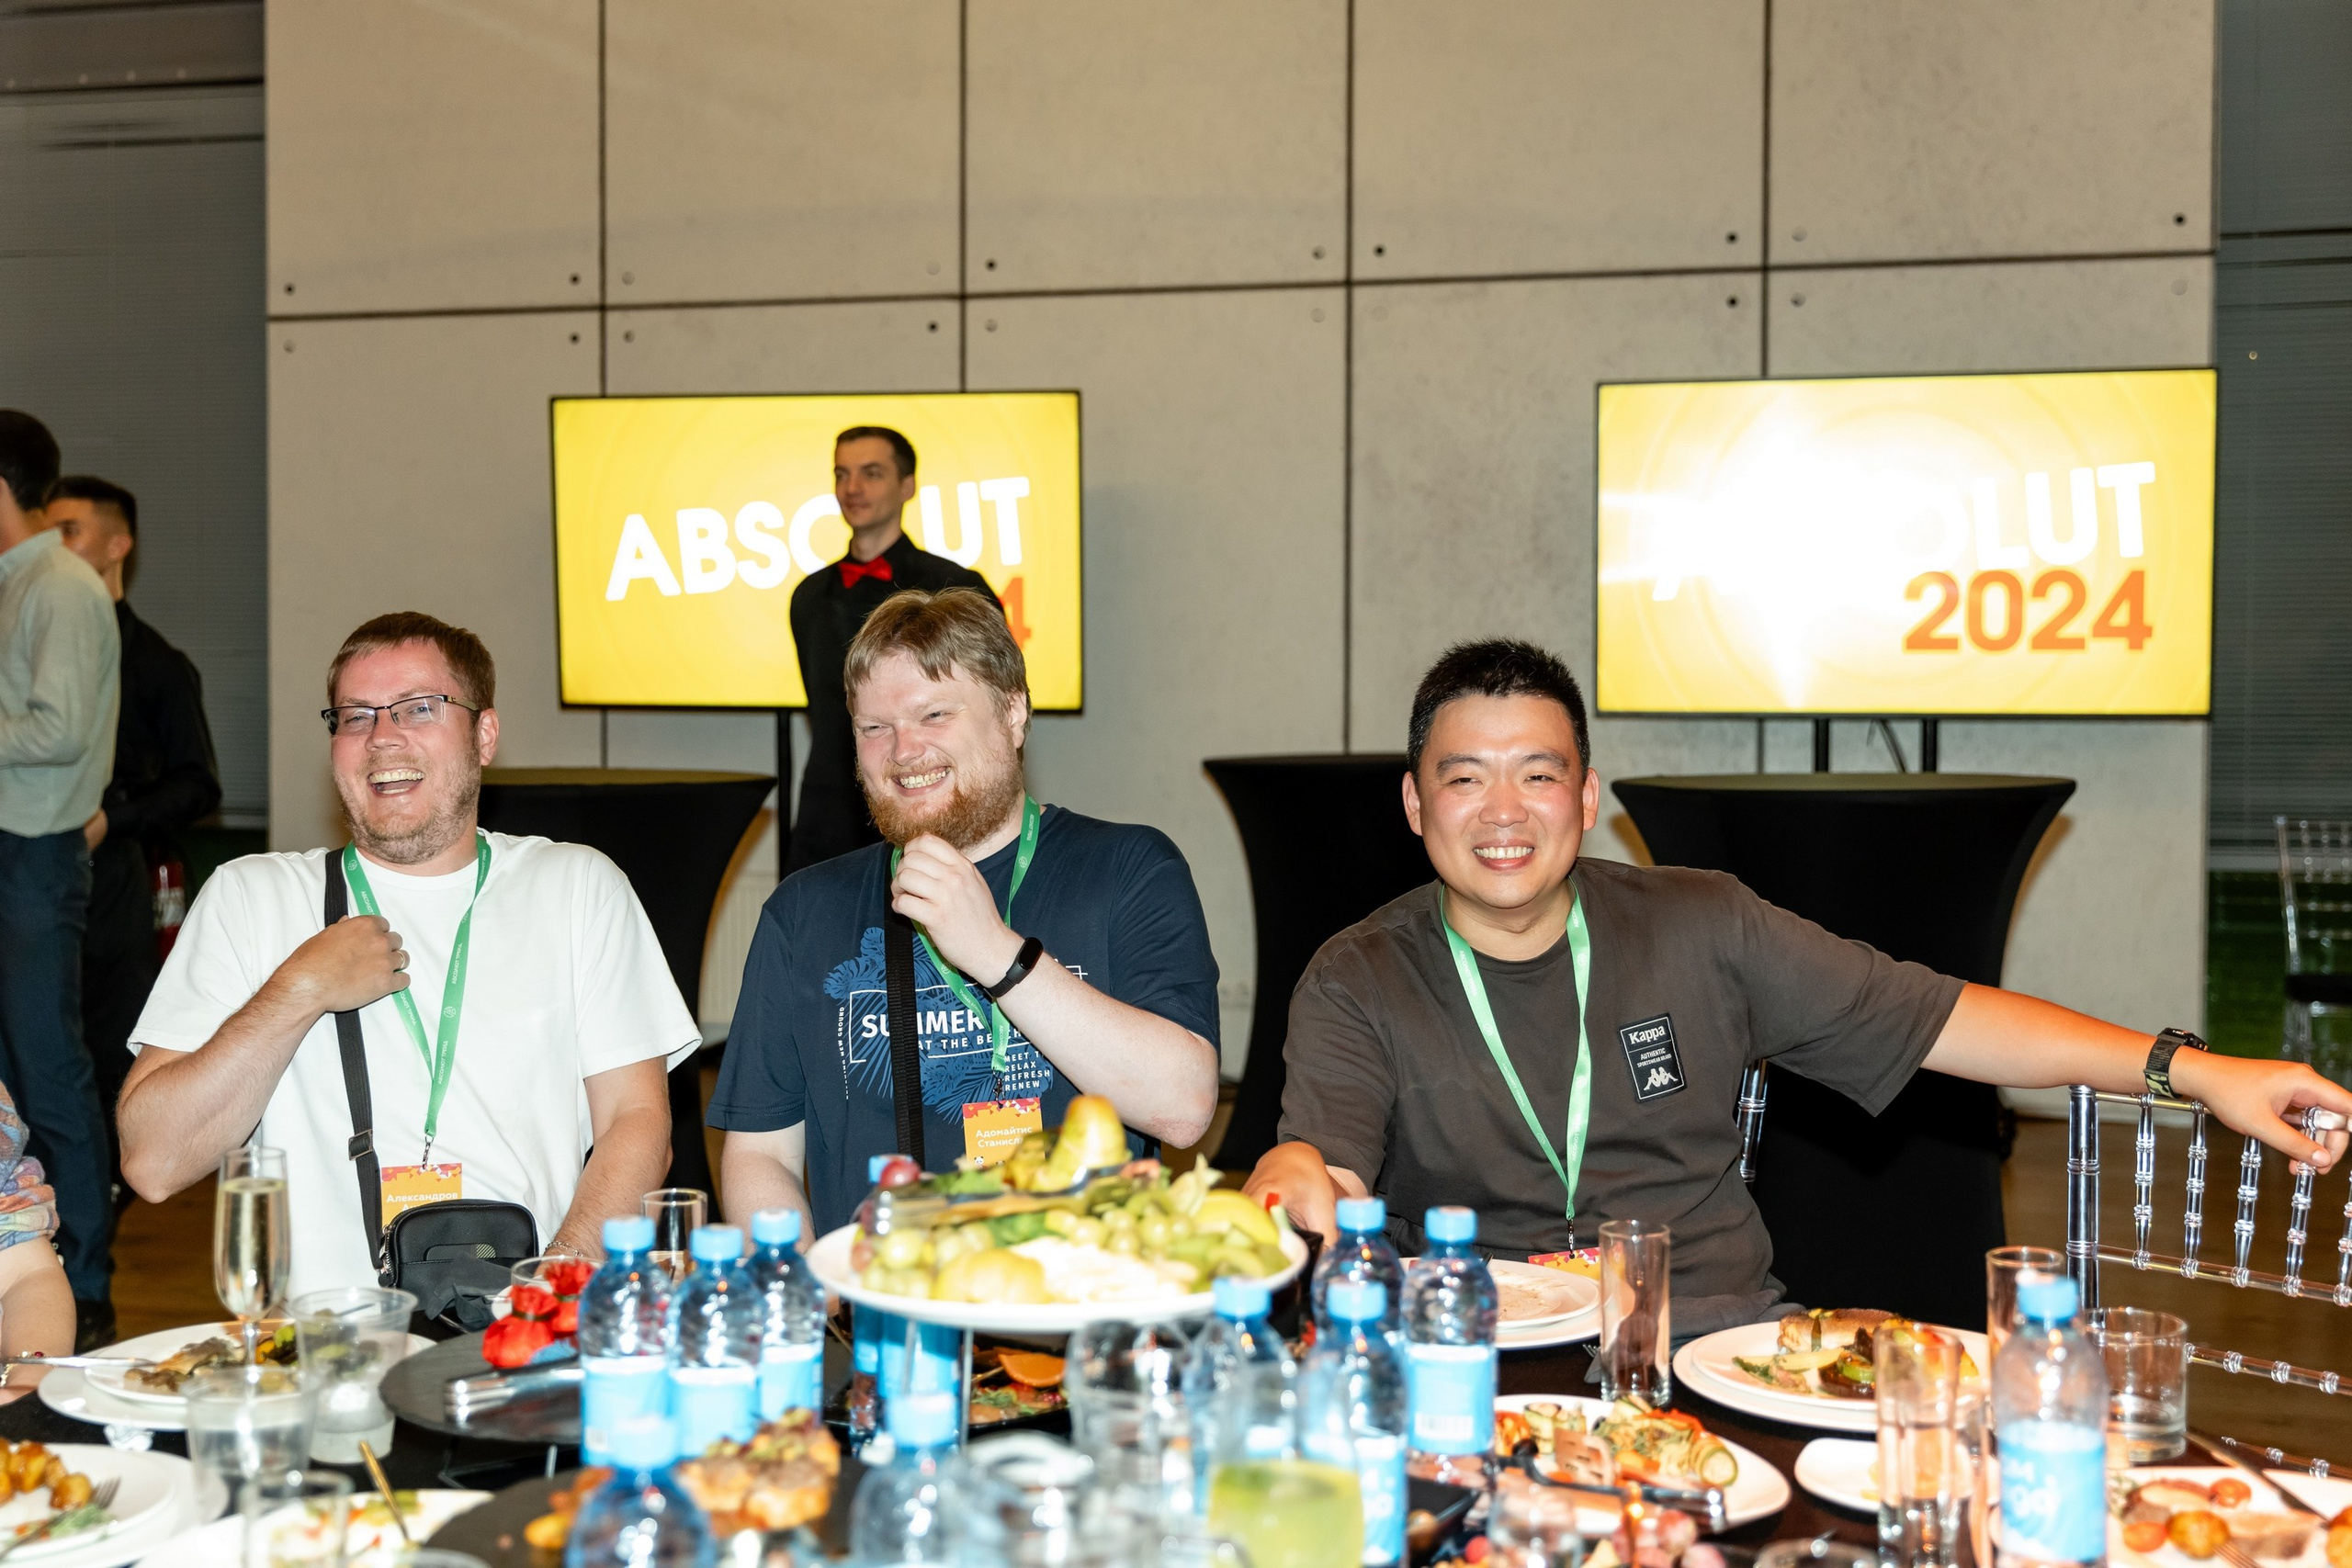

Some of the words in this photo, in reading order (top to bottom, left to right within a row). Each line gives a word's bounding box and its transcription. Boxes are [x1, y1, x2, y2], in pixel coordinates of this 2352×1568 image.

[605, 476, 1031, 602] ABSOUT
[1905, 570, 2154, 651] 2024
[837, 1007, 845, 1037] GROUND
[941, 1037, 968, 1050] THE
[977, 1028, 1022, 1045] BEH
[1628, 1025, 1666, 1044] Kappa
[1003, 1052, 1029, 1063] MEET
[1640, 1047, 1667, 1061] AUTHENTIC
[1004, 1061, 1036, 1073] RELAX
[1004, 1069, 1050, 1082] REFRESH
[1004, 1080, 1040, 1091] RENEW
[976, 1126, 1033, 1139] Адомайтис
[978, 1137, 1022, 1148] Станисл
[386, 1192, 458, 1203] Александров
